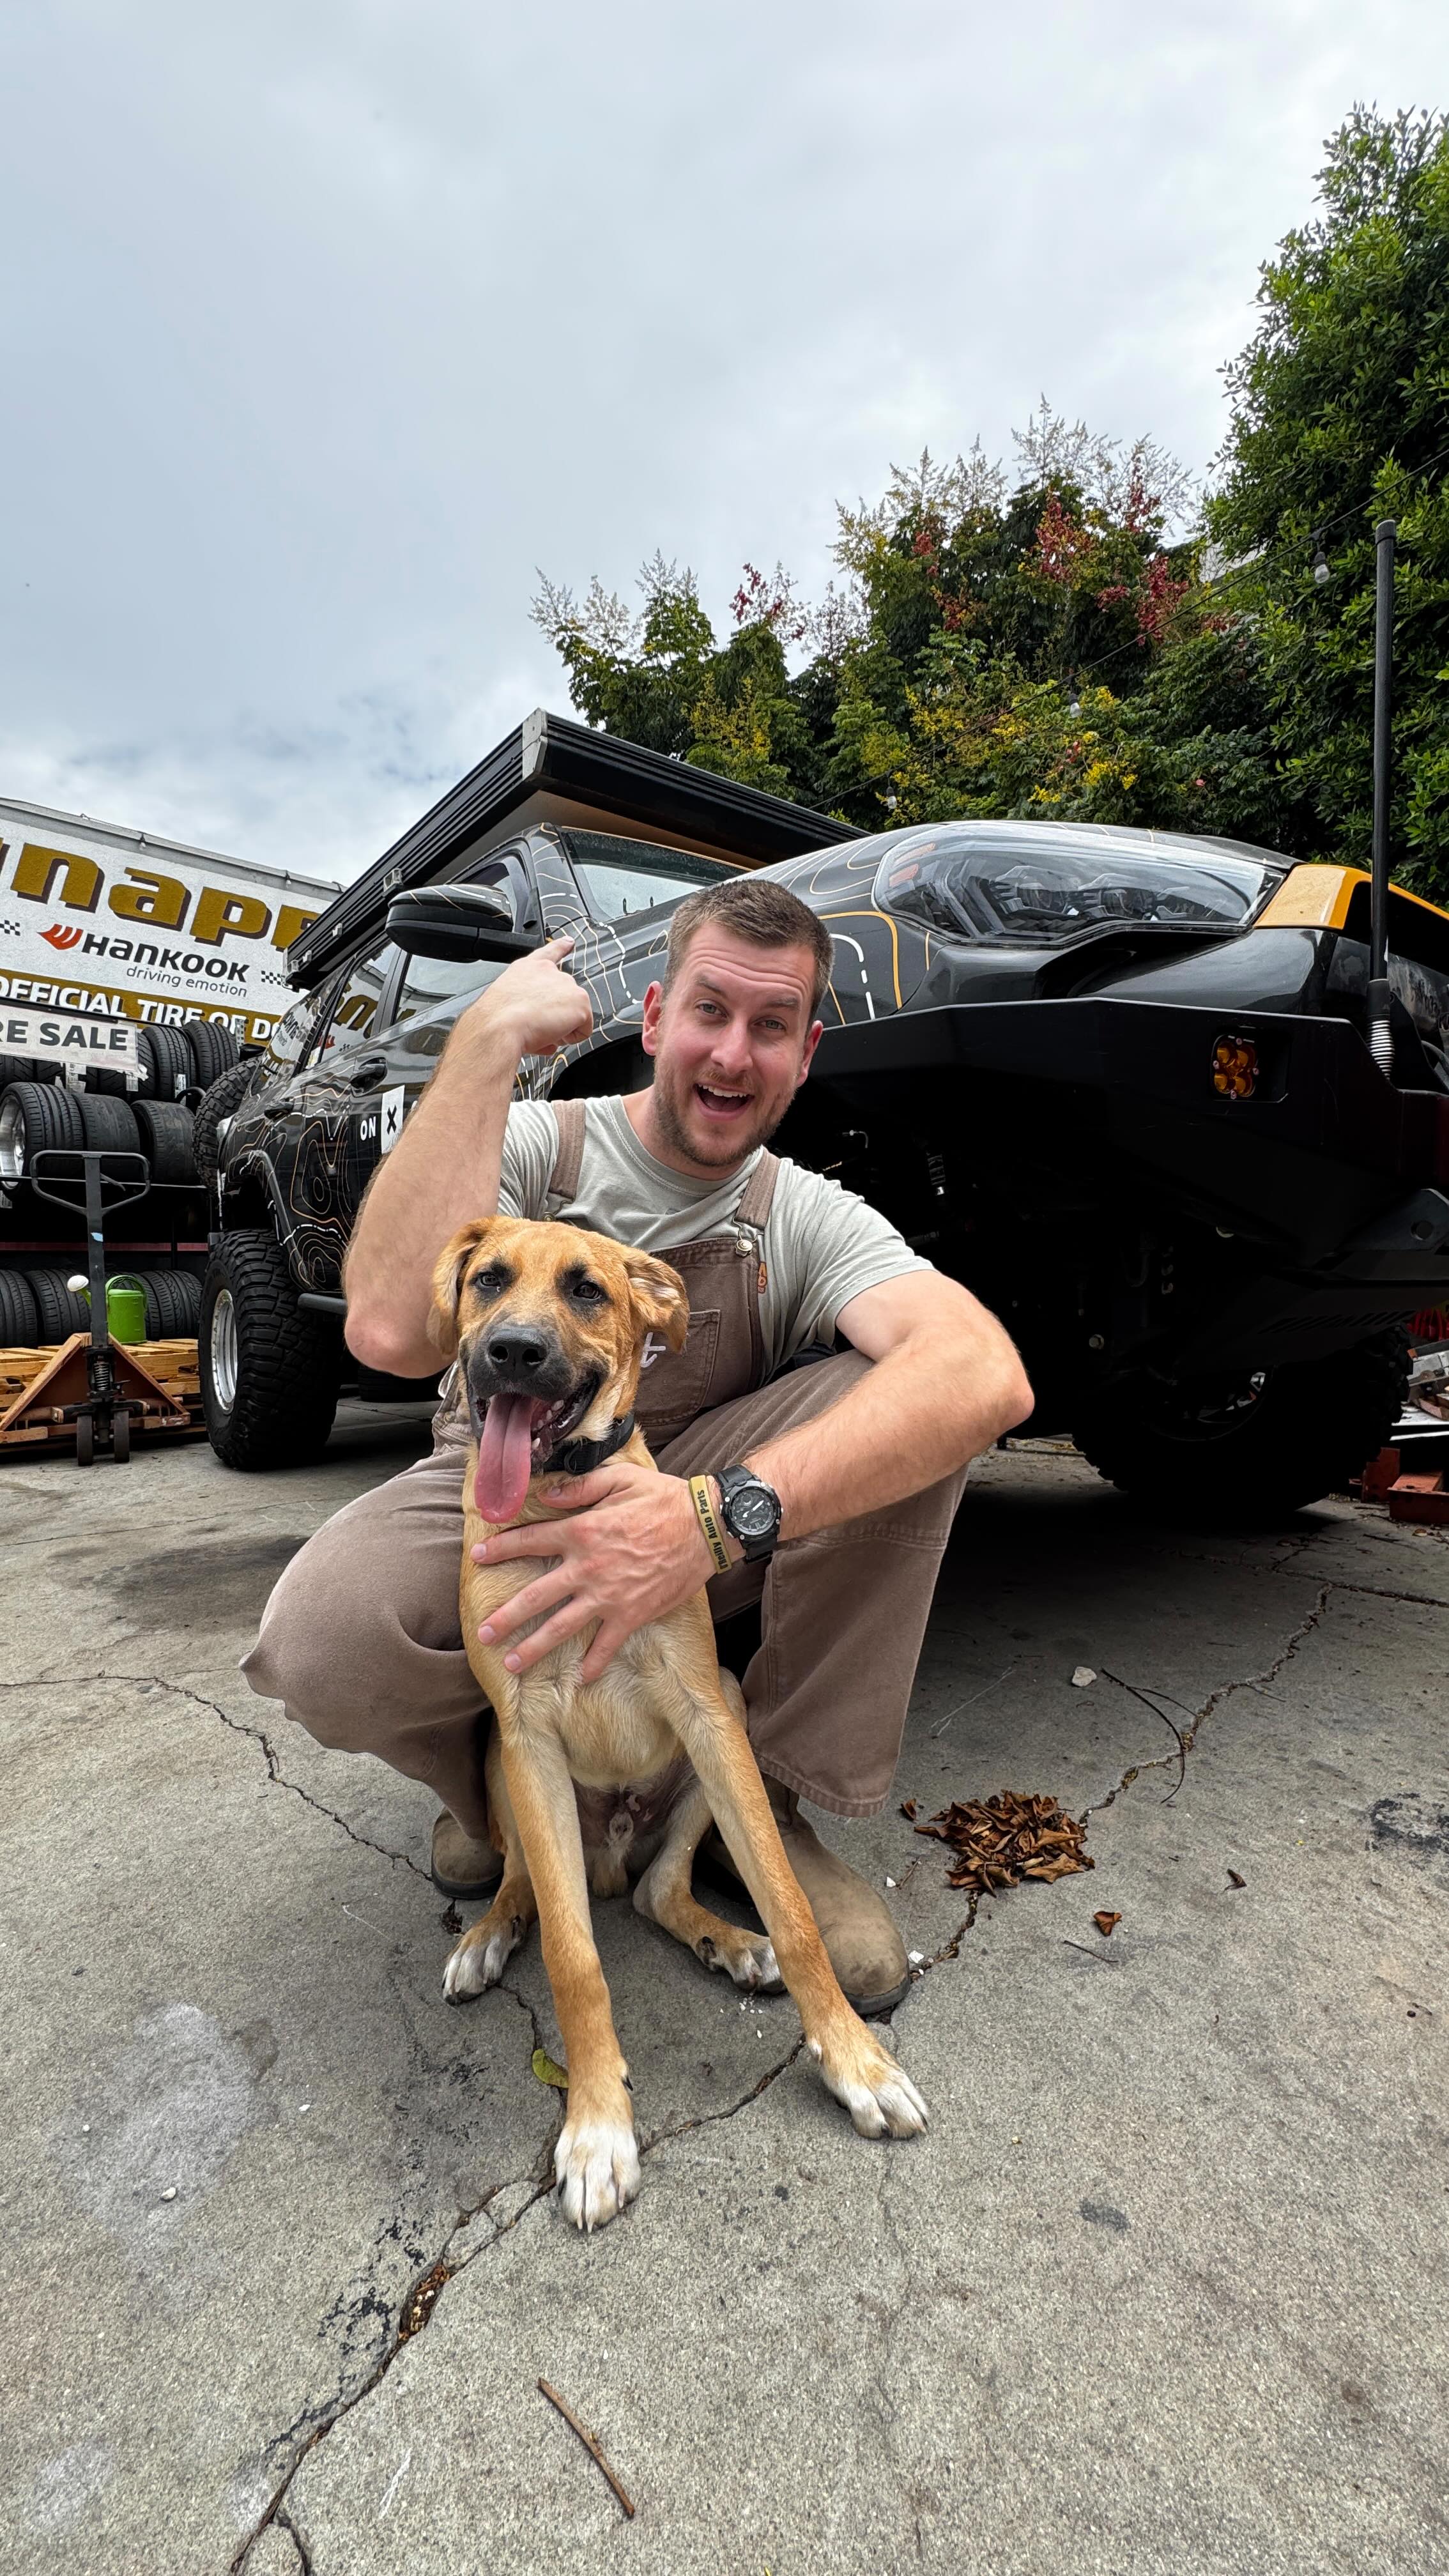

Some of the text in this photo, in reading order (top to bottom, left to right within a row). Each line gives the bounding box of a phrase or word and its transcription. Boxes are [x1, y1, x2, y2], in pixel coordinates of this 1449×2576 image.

[0, 836, 322, 953] nap
[126, 965, 247, 997] driving emotion
[0, 1020, 128, 1051] E SALE
[360, 1116, 376, 1140] ON
[697, 1489, 710, 1515] Parts
[704, 1516, 718, 1539] Auto
